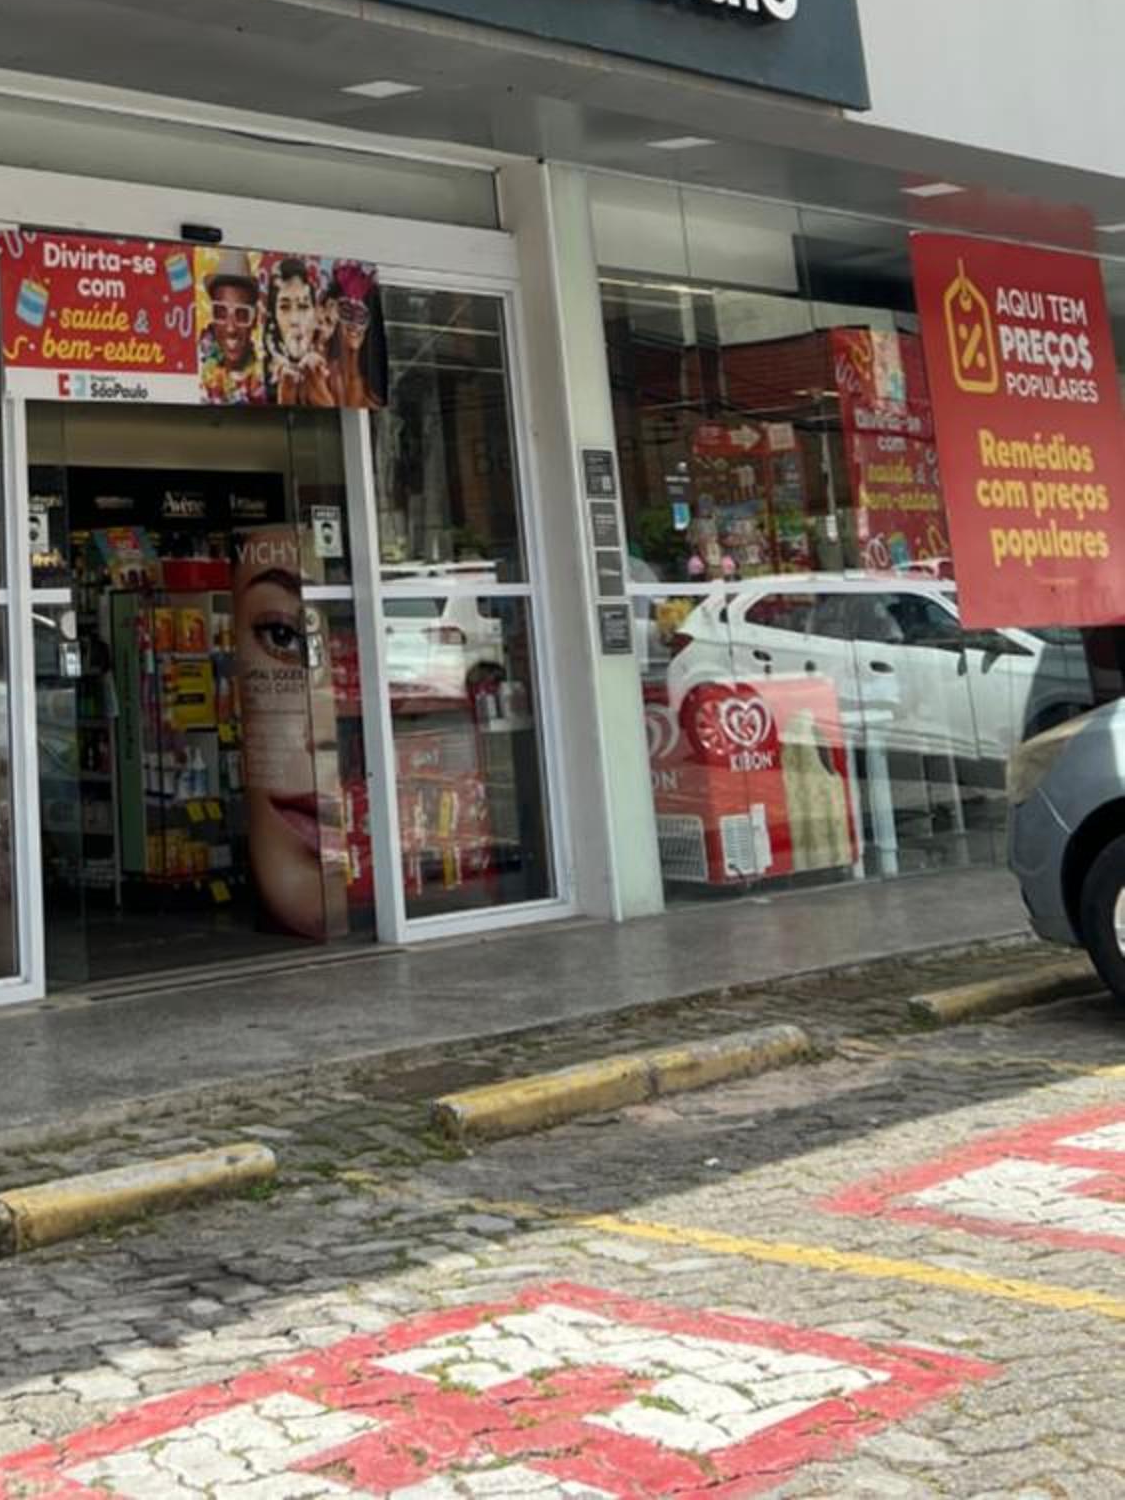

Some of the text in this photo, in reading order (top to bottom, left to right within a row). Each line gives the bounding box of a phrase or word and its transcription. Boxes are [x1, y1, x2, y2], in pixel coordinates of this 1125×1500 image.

[43, 242, 156, 274] Divirta-se
[78, 277, 125, 298] com
[59, 302, 150, 334] saúde &
[996, 286, 1088, 326] AQUI TEM
[42, 329, 165, 364] bem-estar
[1005, 371, 1099, 404] POPULARES
[978, 428, 1094, 473] Remédios
[976, 478, 1110, 520] com preços
[235, 538, 301, 566] VICHY
[990, 520, 1110, 568] populares
[729, 752, 774, 773] KIBON
